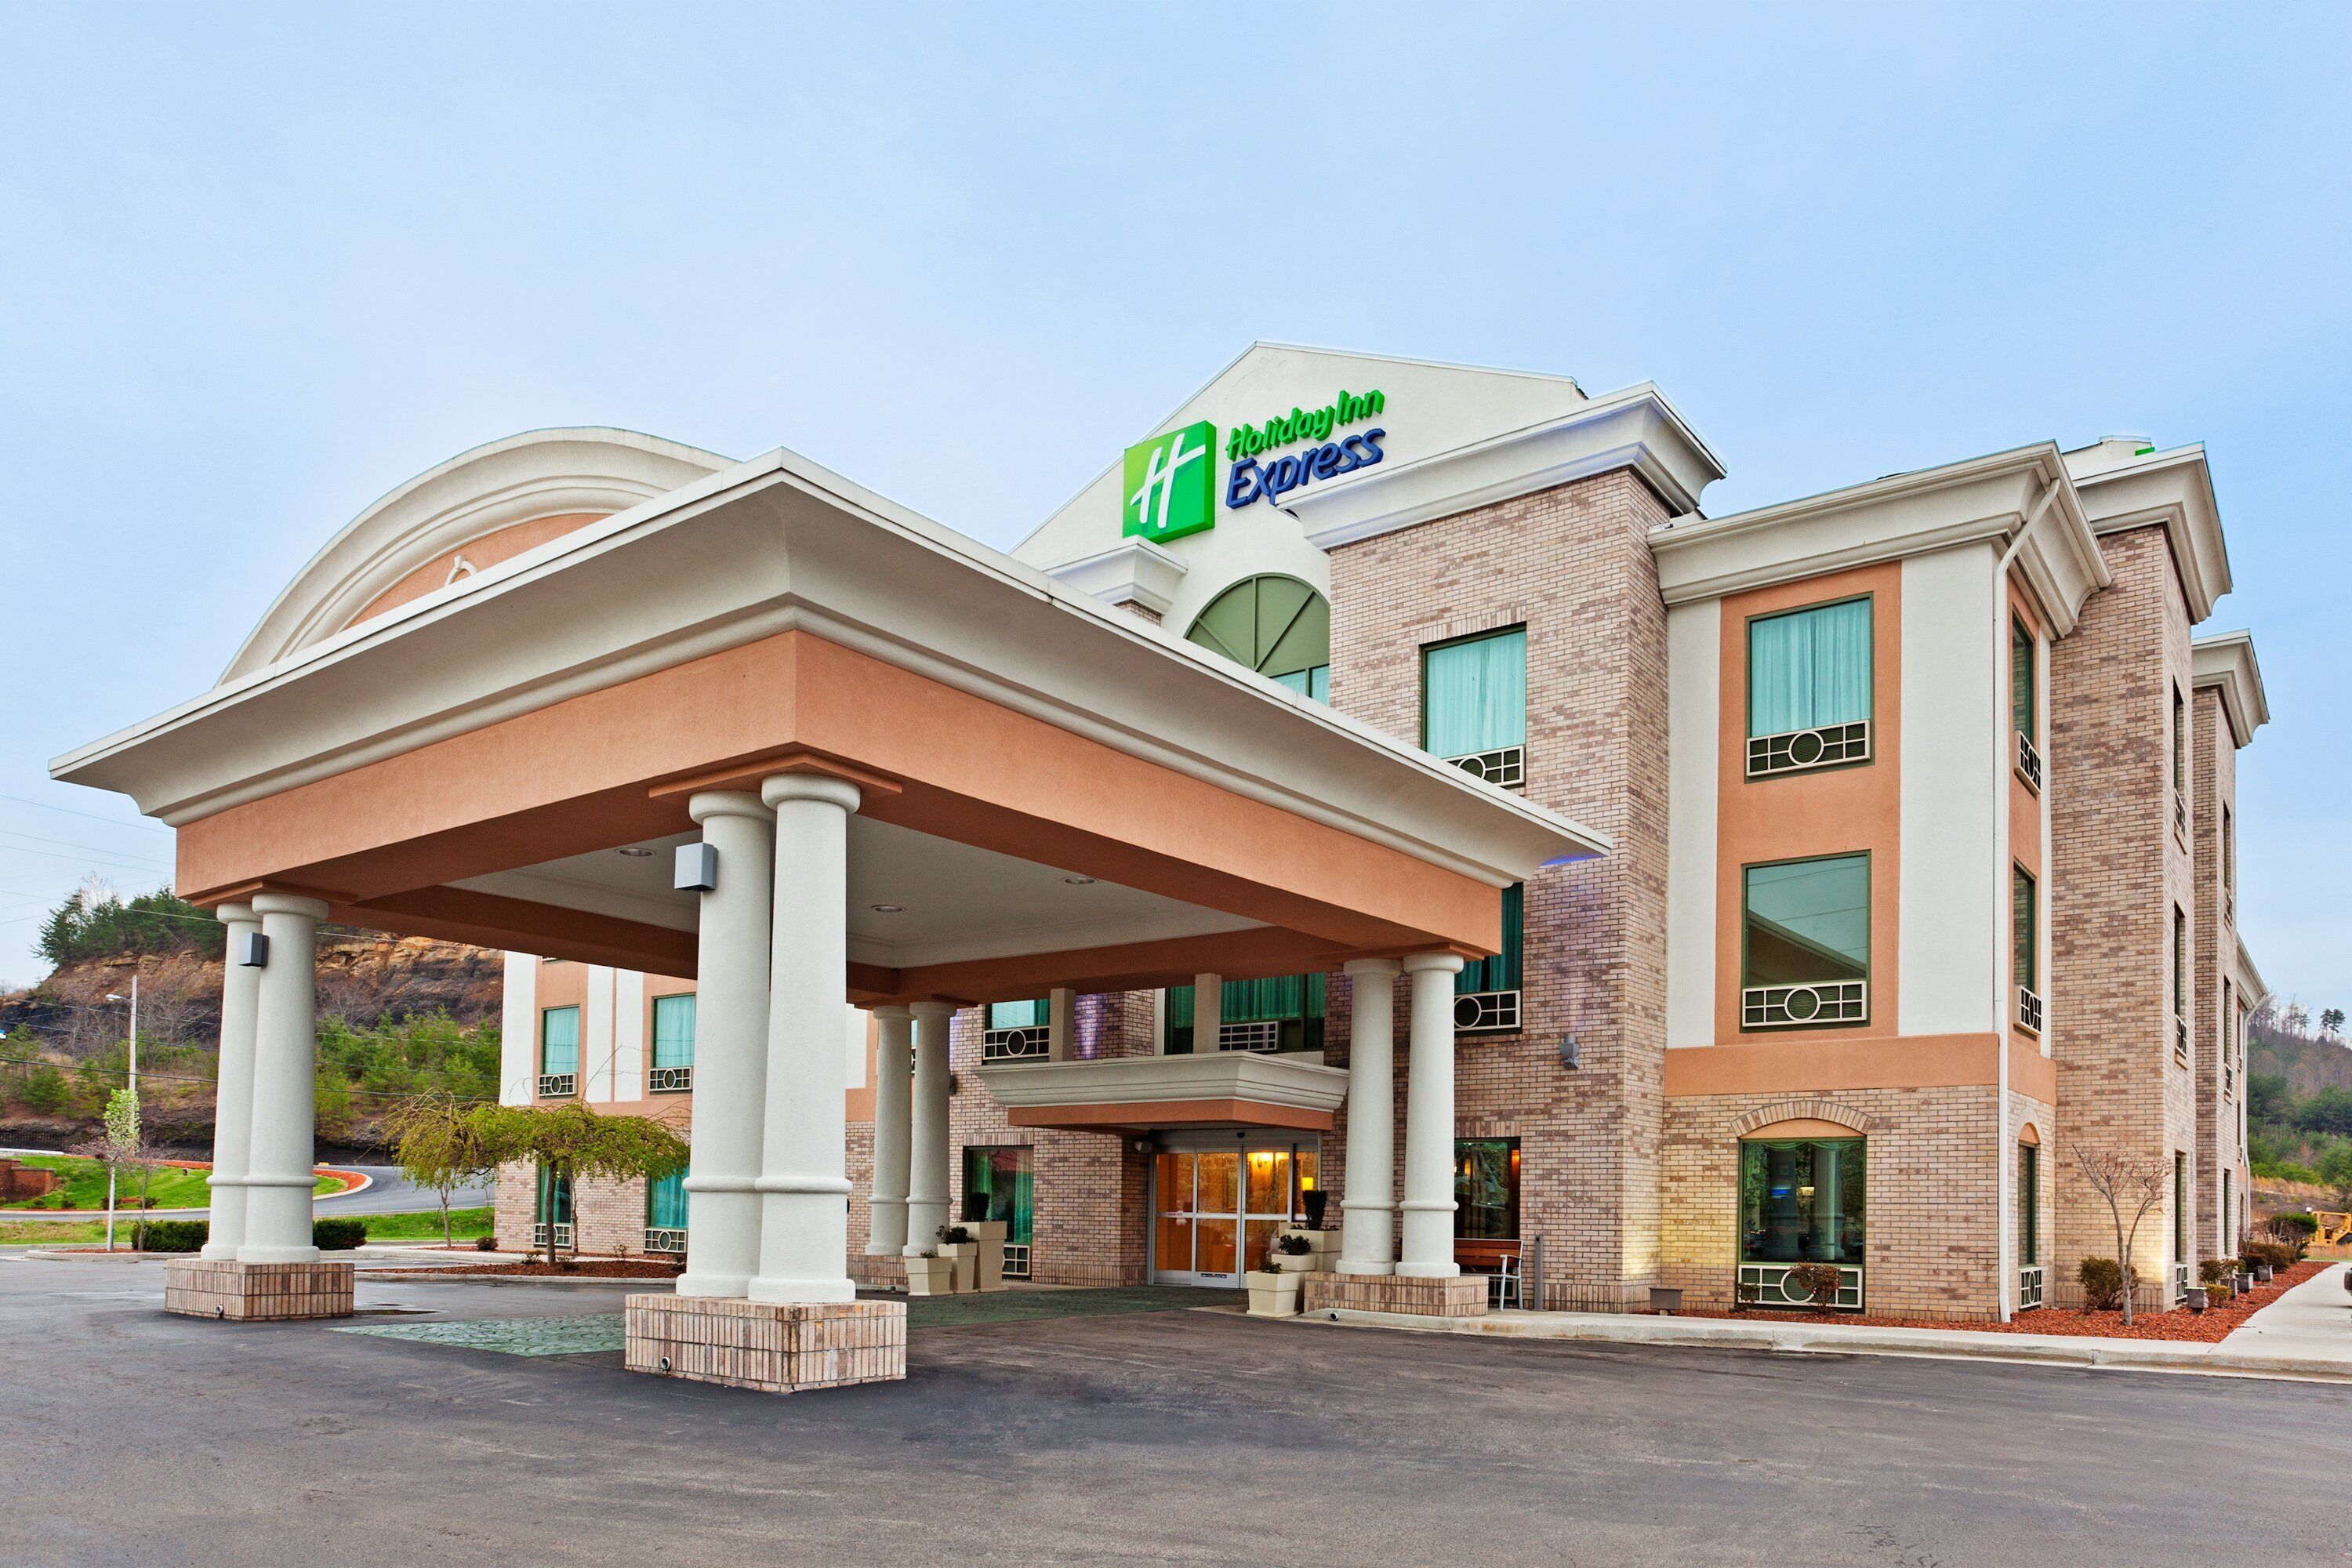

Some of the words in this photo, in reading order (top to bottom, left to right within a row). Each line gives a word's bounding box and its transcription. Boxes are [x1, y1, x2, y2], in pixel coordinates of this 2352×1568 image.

[1225, 405, 1336, 463] Holiday
[1334, 390, 1385, 426] Inn
[1130, 432, 1207, 528] H
[1225, 427, 1386, 510] Express
